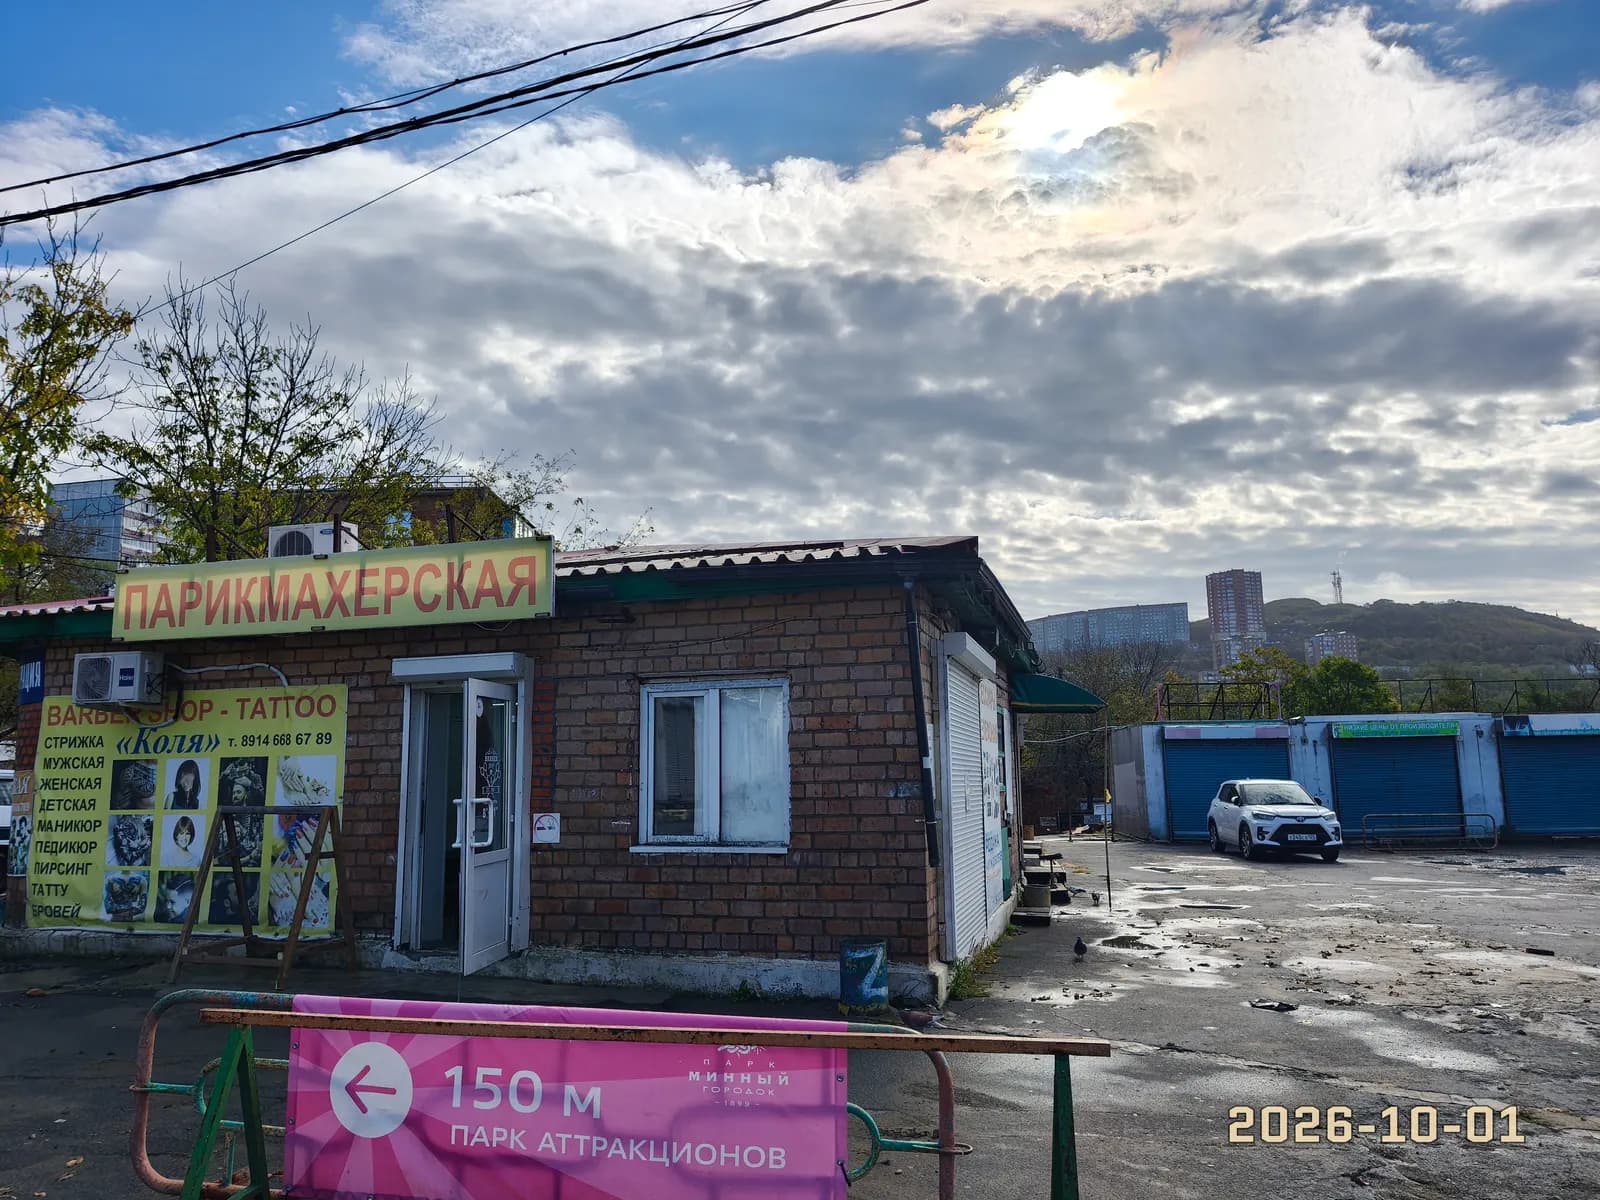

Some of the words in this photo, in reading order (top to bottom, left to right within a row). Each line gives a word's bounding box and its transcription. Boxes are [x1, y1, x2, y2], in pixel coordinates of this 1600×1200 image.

[123, 556, 537, 630] ПАРИКМАХЕРСКАЯ
[236, 694, 337, 720] TATTOO
[44, 736, 104, 749] СТРИЖКА
[241, 734, 270, 747] 8914
[273, 733, 292, 746] 668
[295, 733, 310, 745] 67
[315, 732, 333, 745] 89
[43, 756, 105, 769] МУЖСКАЯ
[39, 777, 102, 791] ЖЕНСКАЯ
[39, 799, 96, 813] ДЕТСКАЯ
[37, 820, 102, 833] МАНИКЮР
[35, 841, 97, 856] ПЕДИКЮР
[34, 863, 92, 876] ПИРСИНГ
[31, 883, 69, 896] ТАТТУ
[31, 903, 81, 919] БРОВЕЙ
[703, 1058, 775, 1069] ПАРК
[688, 1071, 789, 1086] МИННЫЙ
[445, 1065, 542, 1113] 150
[702, 1086, 775, 1096] ГОРОДОК
[450, 1124, 528, 1150] ПАРК
[538, 1132, 787, 1170] АТТРАКЦИОНОВ
